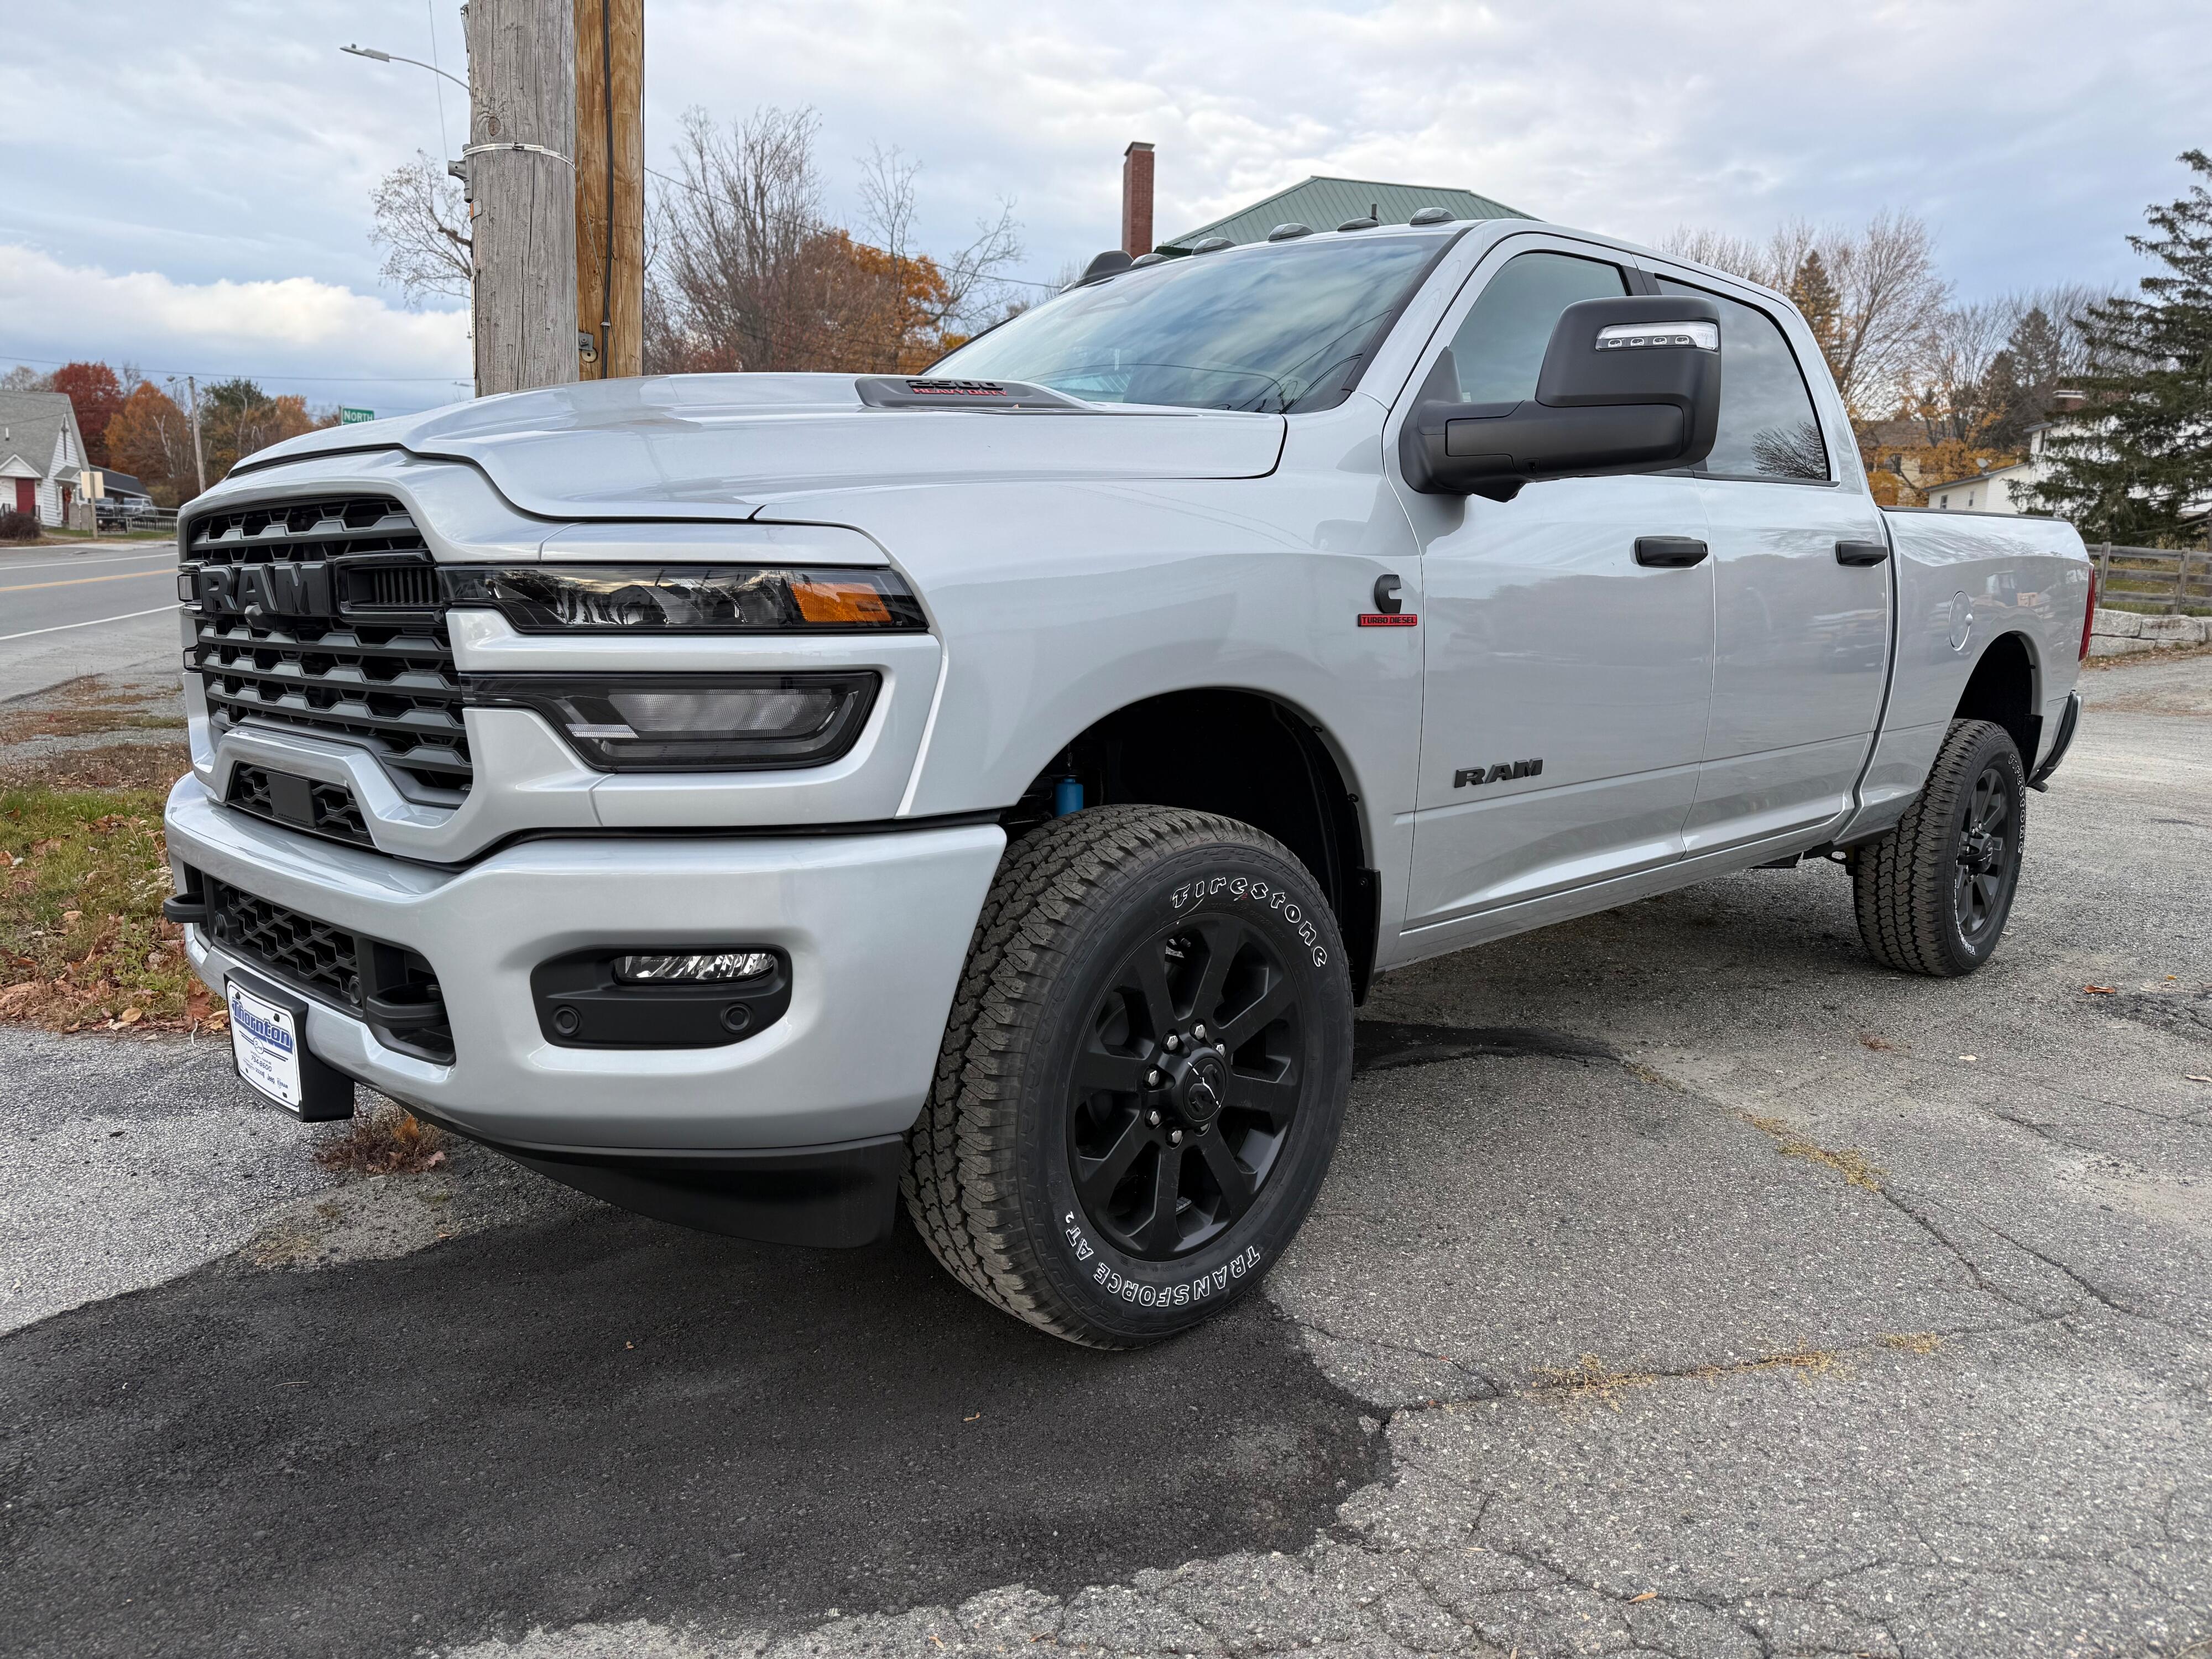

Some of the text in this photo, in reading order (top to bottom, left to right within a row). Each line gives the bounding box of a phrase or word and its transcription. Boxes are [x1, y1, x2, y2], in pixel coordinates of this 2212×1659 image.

[906, 380, 1003, 390] 2500
[344, 410, 373, 422] NORTH
[200, 563, 332, 615] RAM
[1454, 757, 1543, 788] RAM
[1172, 877, 1327, 967] Firestone
[232, 998, 291, 1048] Thornton
[1093, 1245, 1261, 1307] TRANSFORCE
